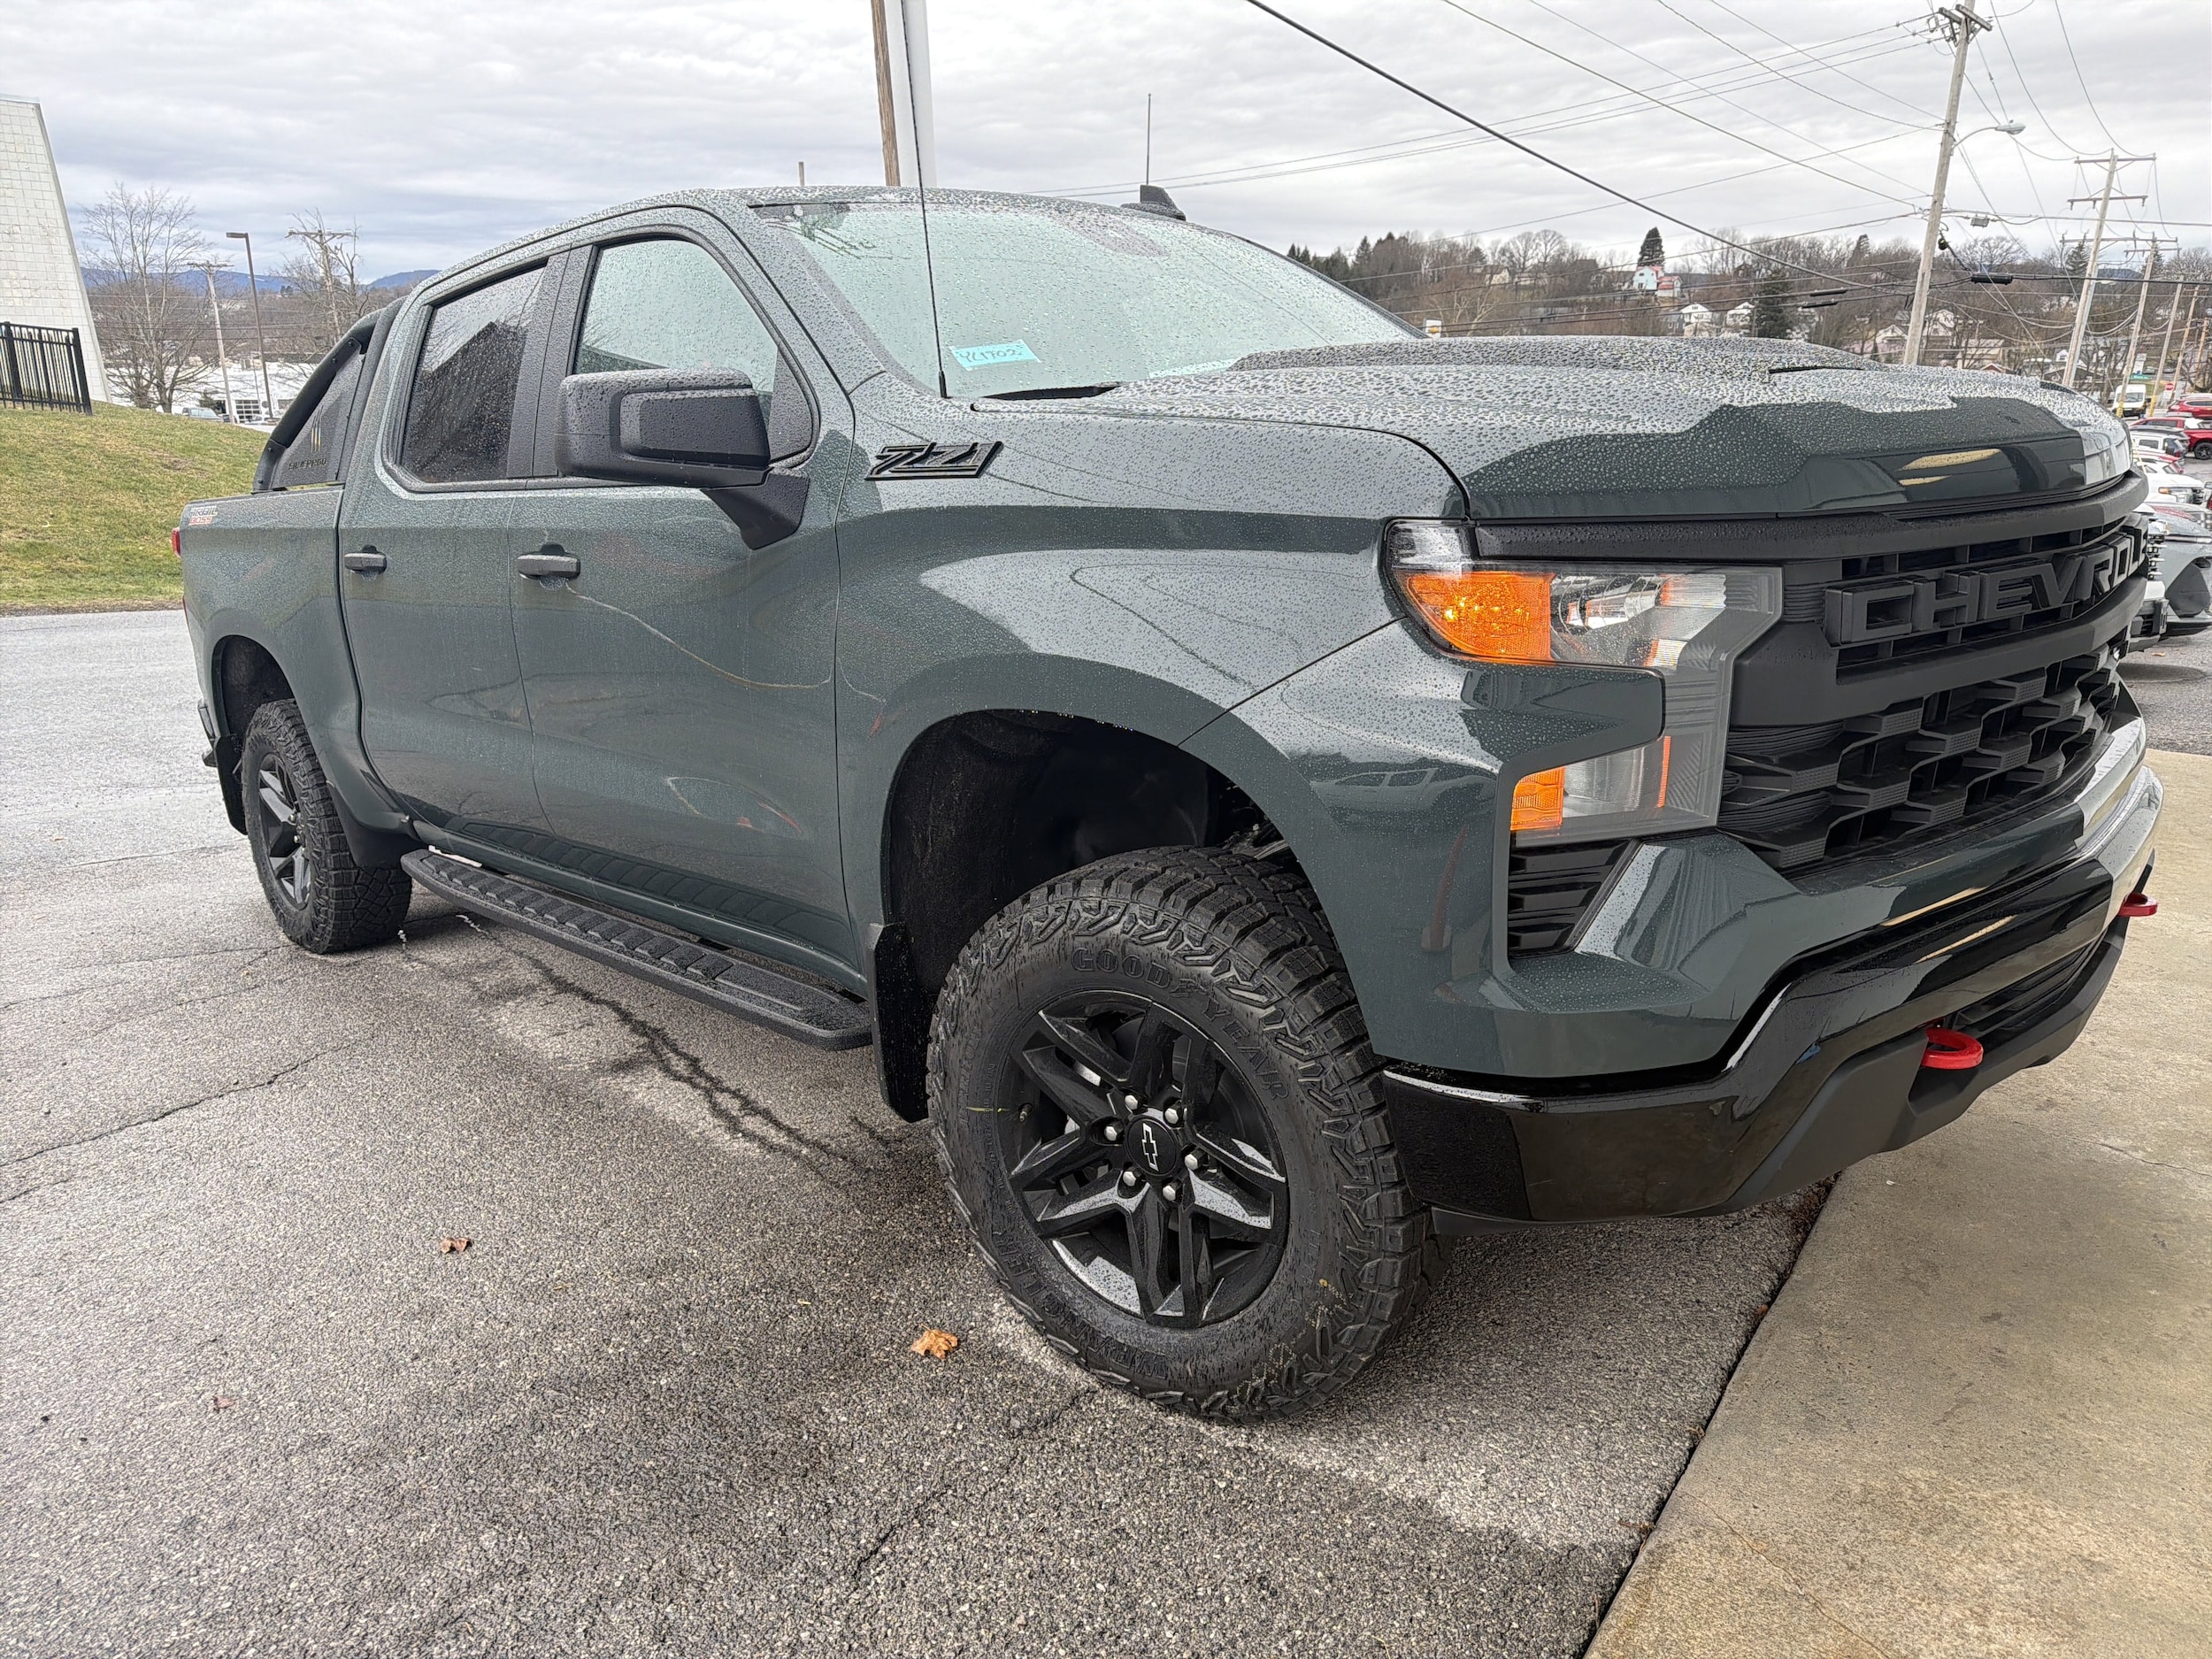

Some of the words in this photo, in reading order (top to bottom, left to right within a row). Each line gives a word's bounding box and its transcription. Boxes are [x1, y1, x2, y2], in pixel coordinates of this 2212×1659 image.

[190, 505, 218, 517] TRAIL
[188, 516, 213, 526] BOSS
[1071, 947, 1289, 1101] GOODYEAR
